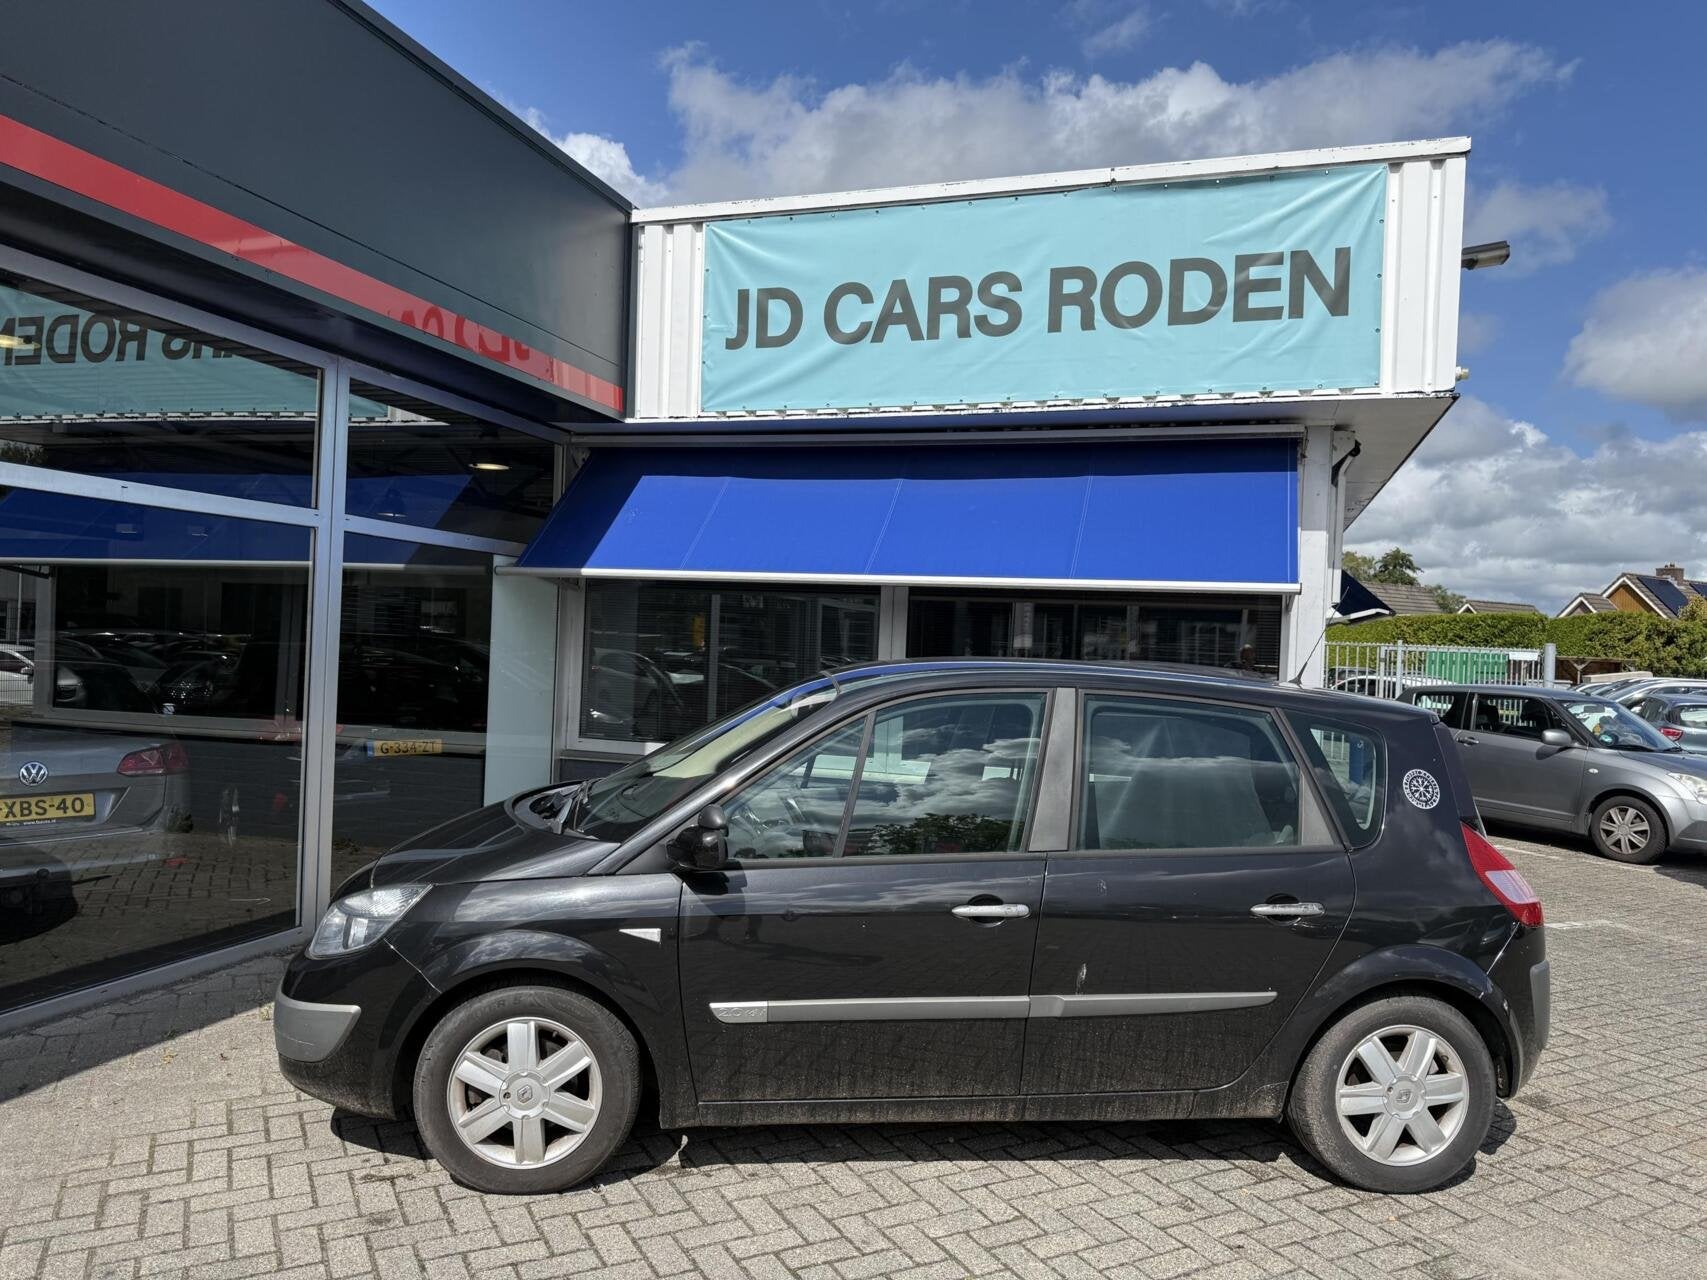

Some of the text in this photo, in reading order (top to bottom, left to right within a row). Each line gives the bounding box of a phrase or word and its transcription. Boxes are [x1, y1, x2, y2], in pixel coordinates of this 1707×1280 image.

[724, 245, 1352, 351] JD CARS RODEN
